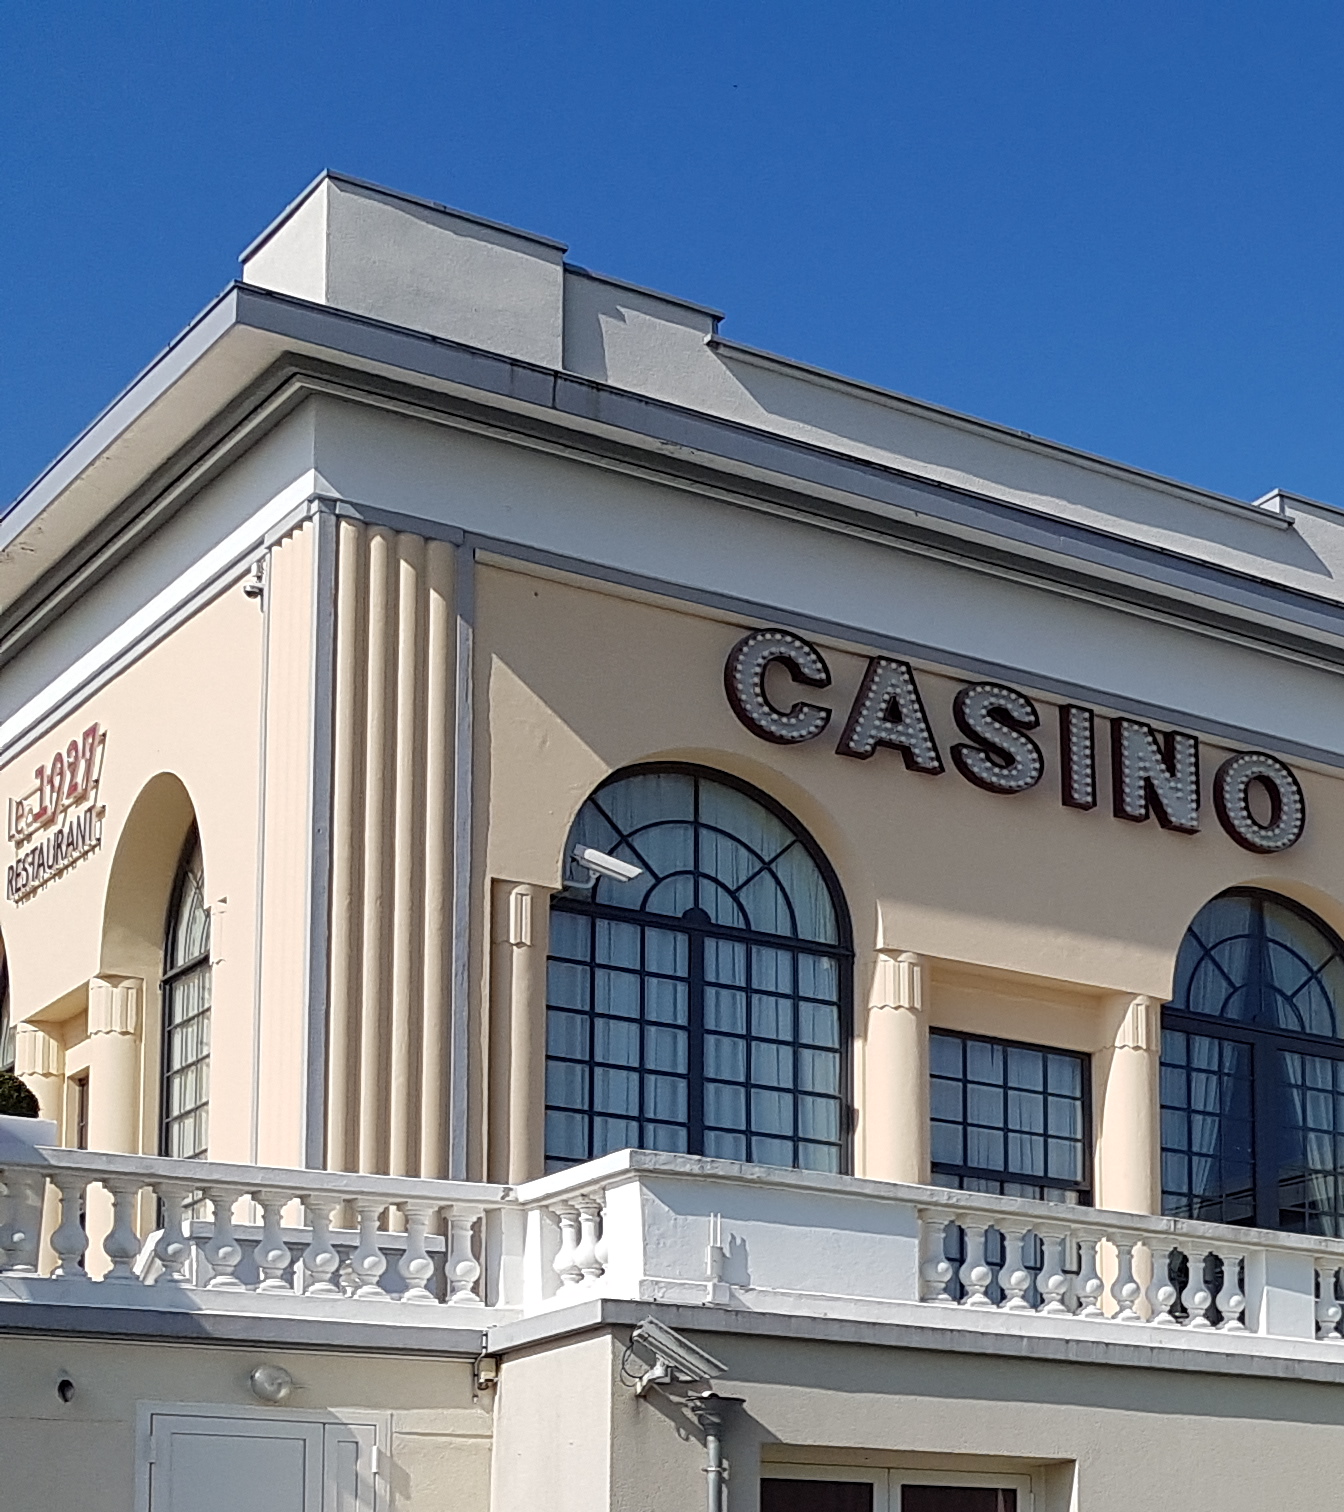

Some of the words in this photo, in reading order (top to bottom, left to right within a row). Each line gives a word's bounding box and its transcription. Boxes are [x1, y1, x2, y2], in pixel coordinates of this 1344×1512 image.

[34, 722, 100, 823] 1927
[723, 628, 1306, 854] CASINO
[7, 806, 99, 899] RESTAURANT
